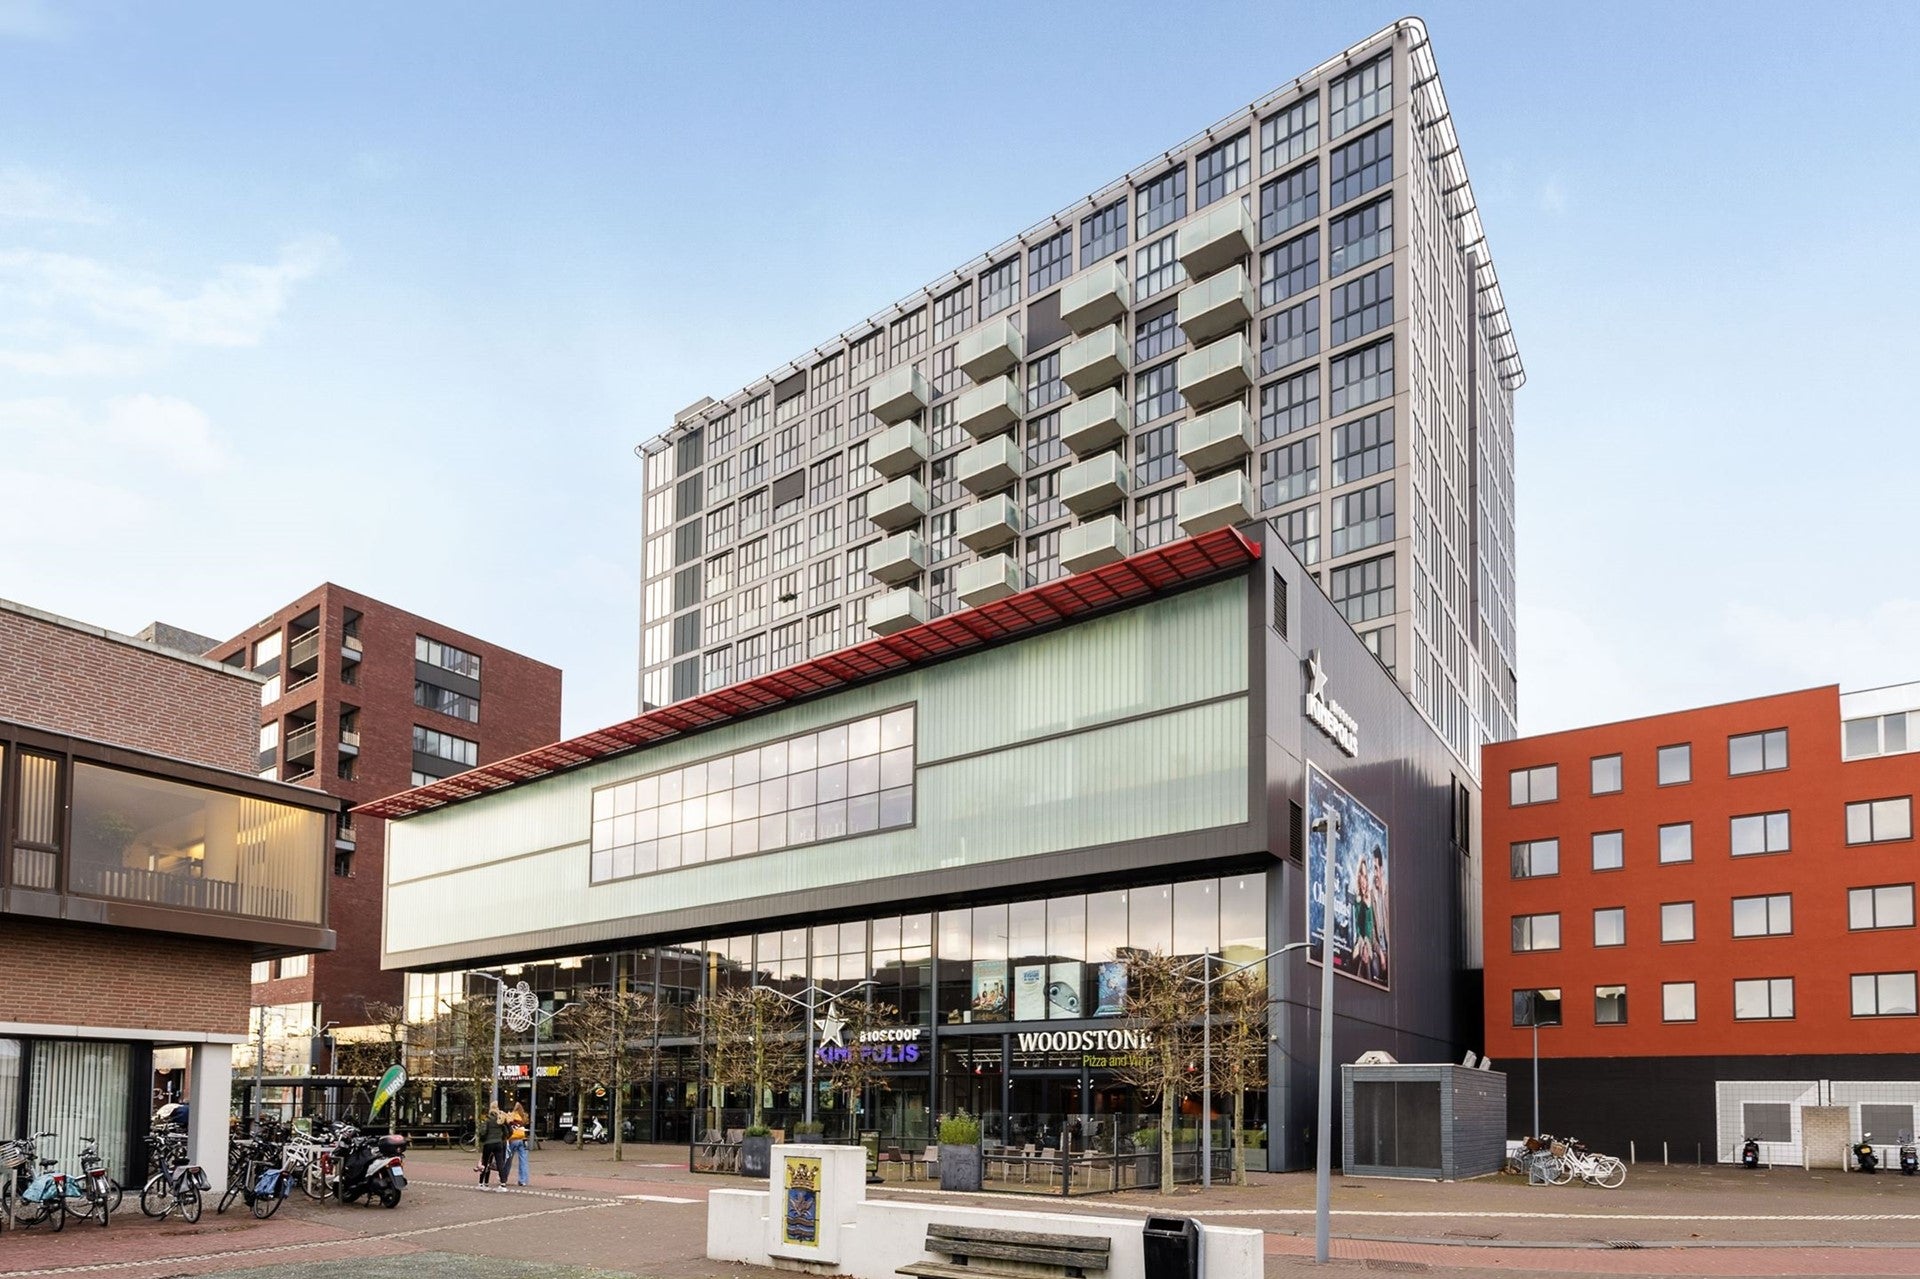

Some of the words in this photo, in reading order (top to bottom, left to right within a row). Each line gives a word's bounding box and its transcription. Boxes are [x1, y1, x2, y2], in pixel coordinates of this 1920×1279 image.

[860, 1028, 920, 1042] BIOSCOOP
[816, 1043, 920, 1062] KINPOLIS
[1082, 1054, 1107, 1067] Pizza
[1109, 1054, 1127, 1067] and
